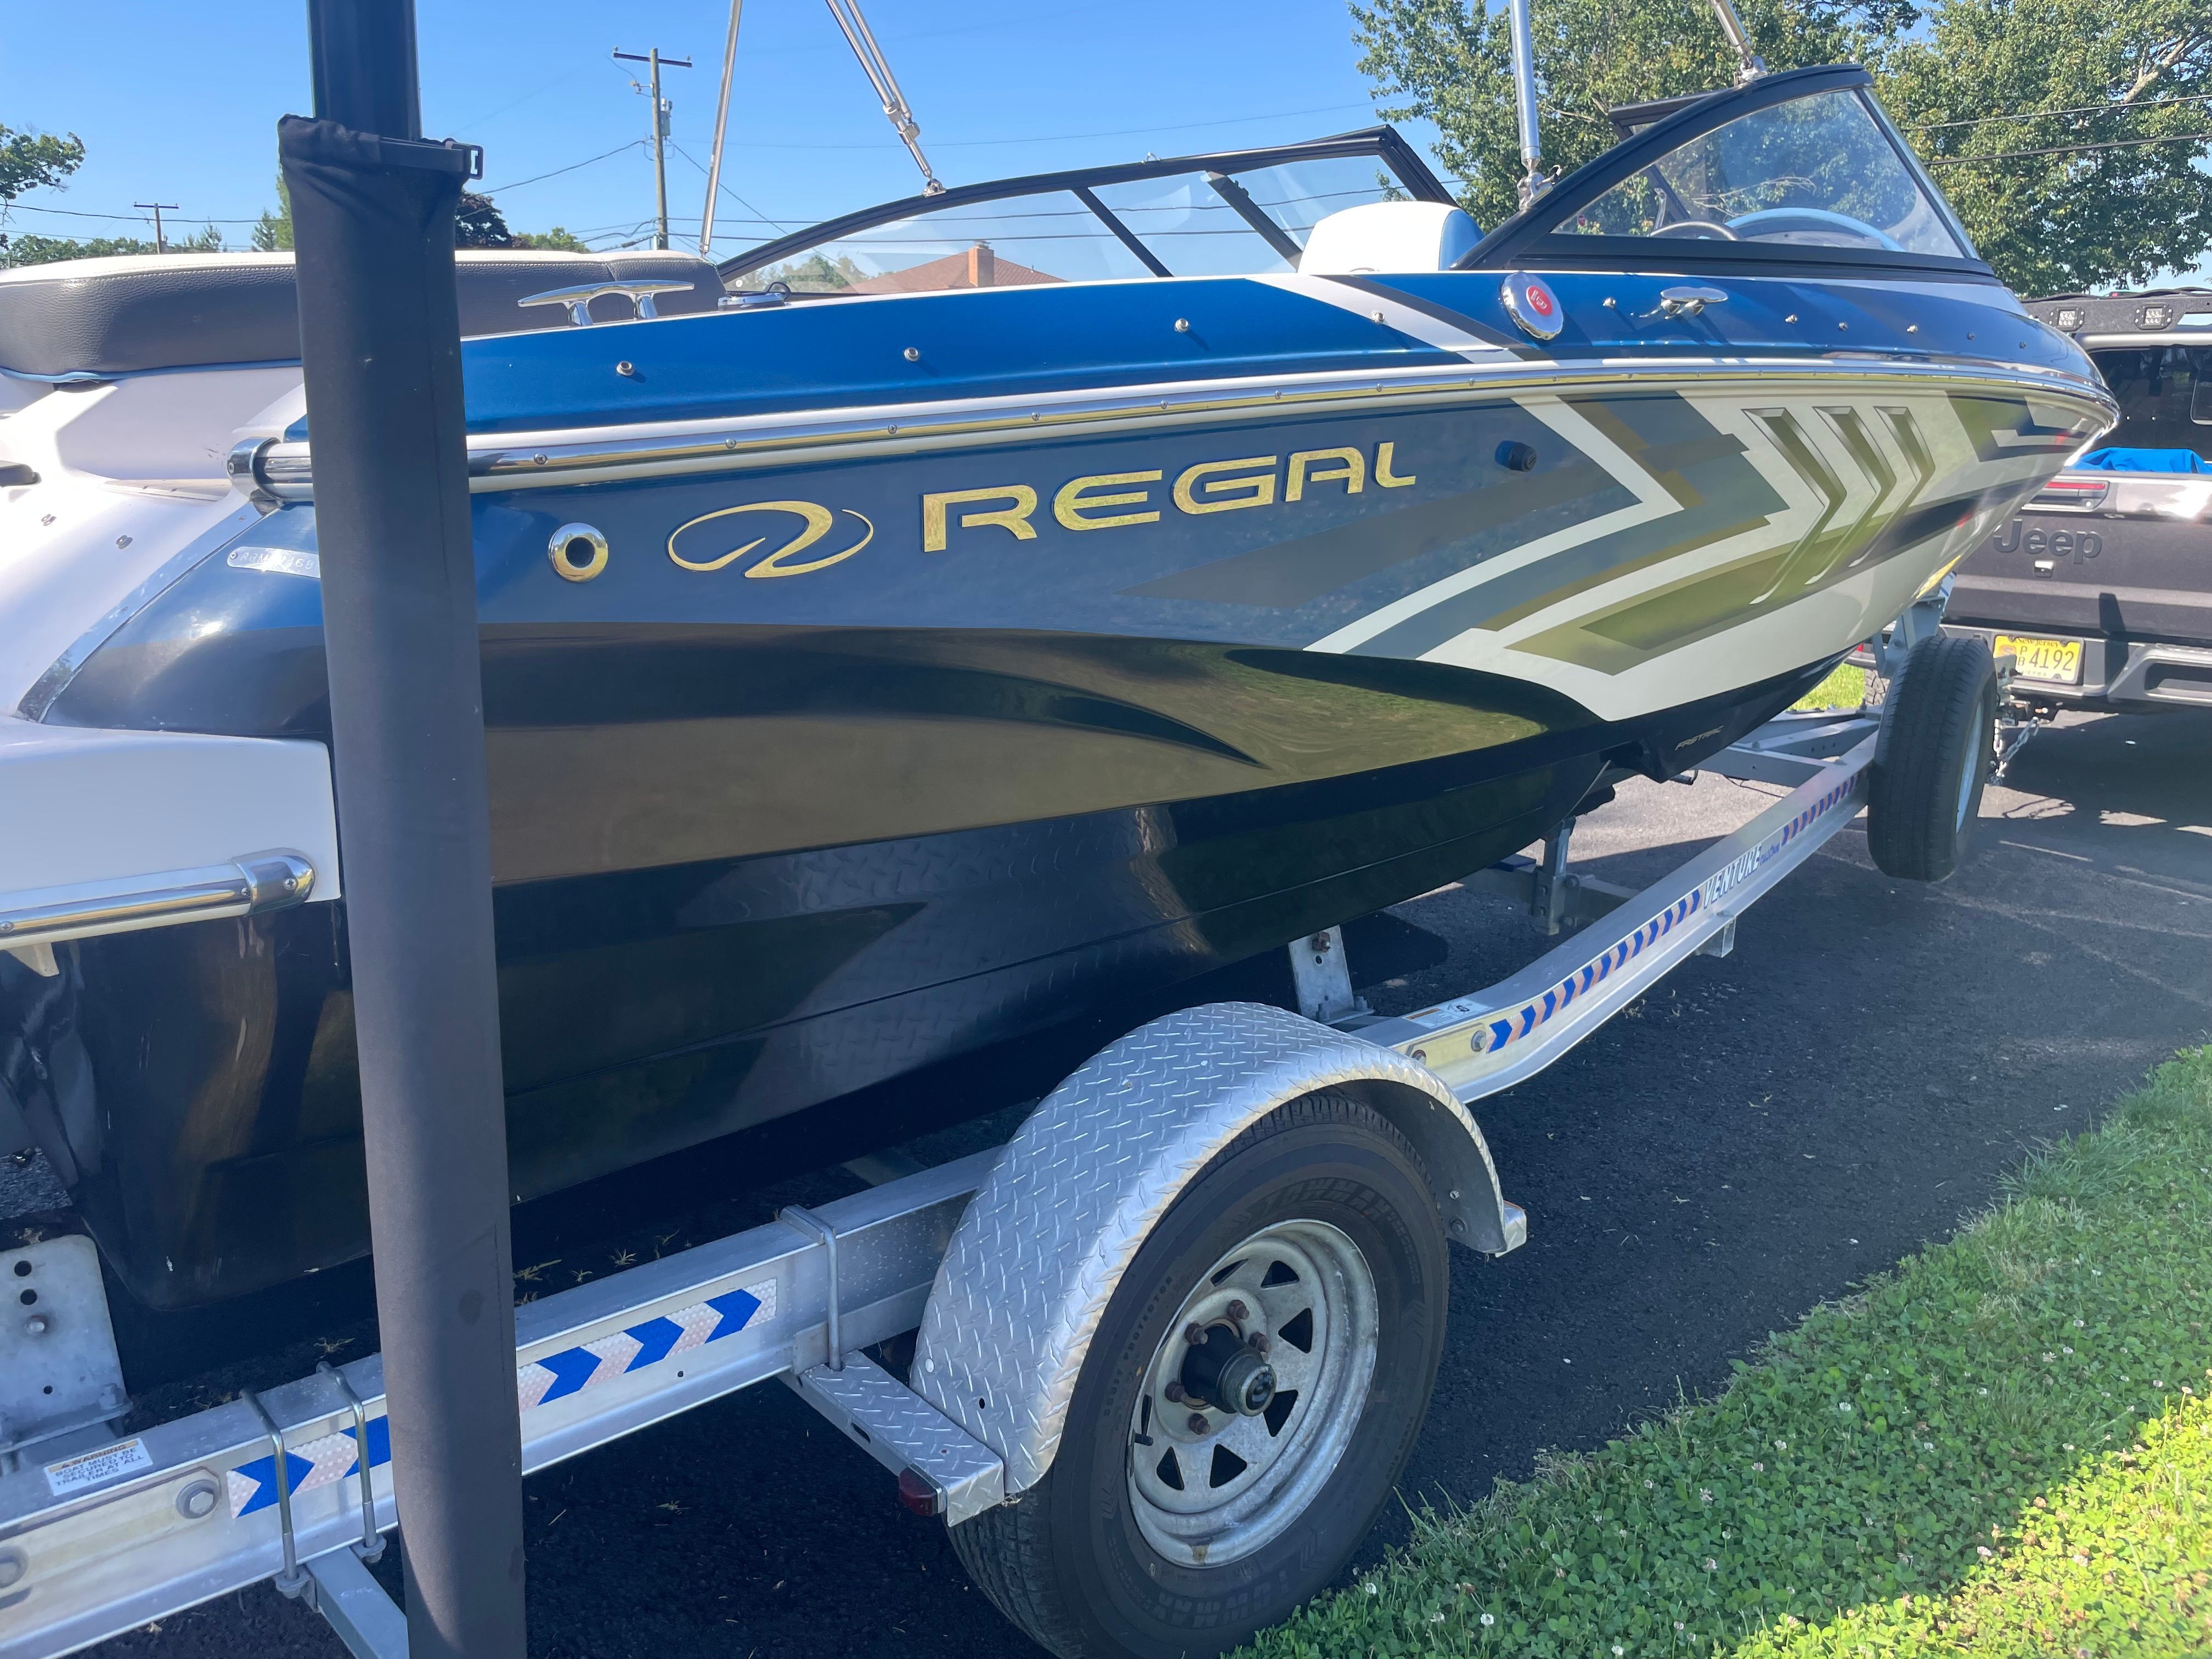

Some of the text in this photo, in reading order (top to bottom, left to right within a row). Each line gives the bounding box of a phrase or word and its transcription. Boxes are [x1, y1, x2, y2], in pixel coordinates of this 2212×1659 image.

[922, 441, 1417, 553] REGAL
[1993, 518, 2102, 565] Jeep
[2029, 647, 2074, 672] 4192
[1703, 843, 1762, 909] VENTURE
[56, 1447, 137, 1477] BOAT MUST BE
[63, 1453, 133, 1479] SECURED TO
[71, 1444, 127, 1465] WARNING
[55, 1455, 145, 1486] TRAILER AT ALL
[86, 1468, 120, 1481] TIMES
